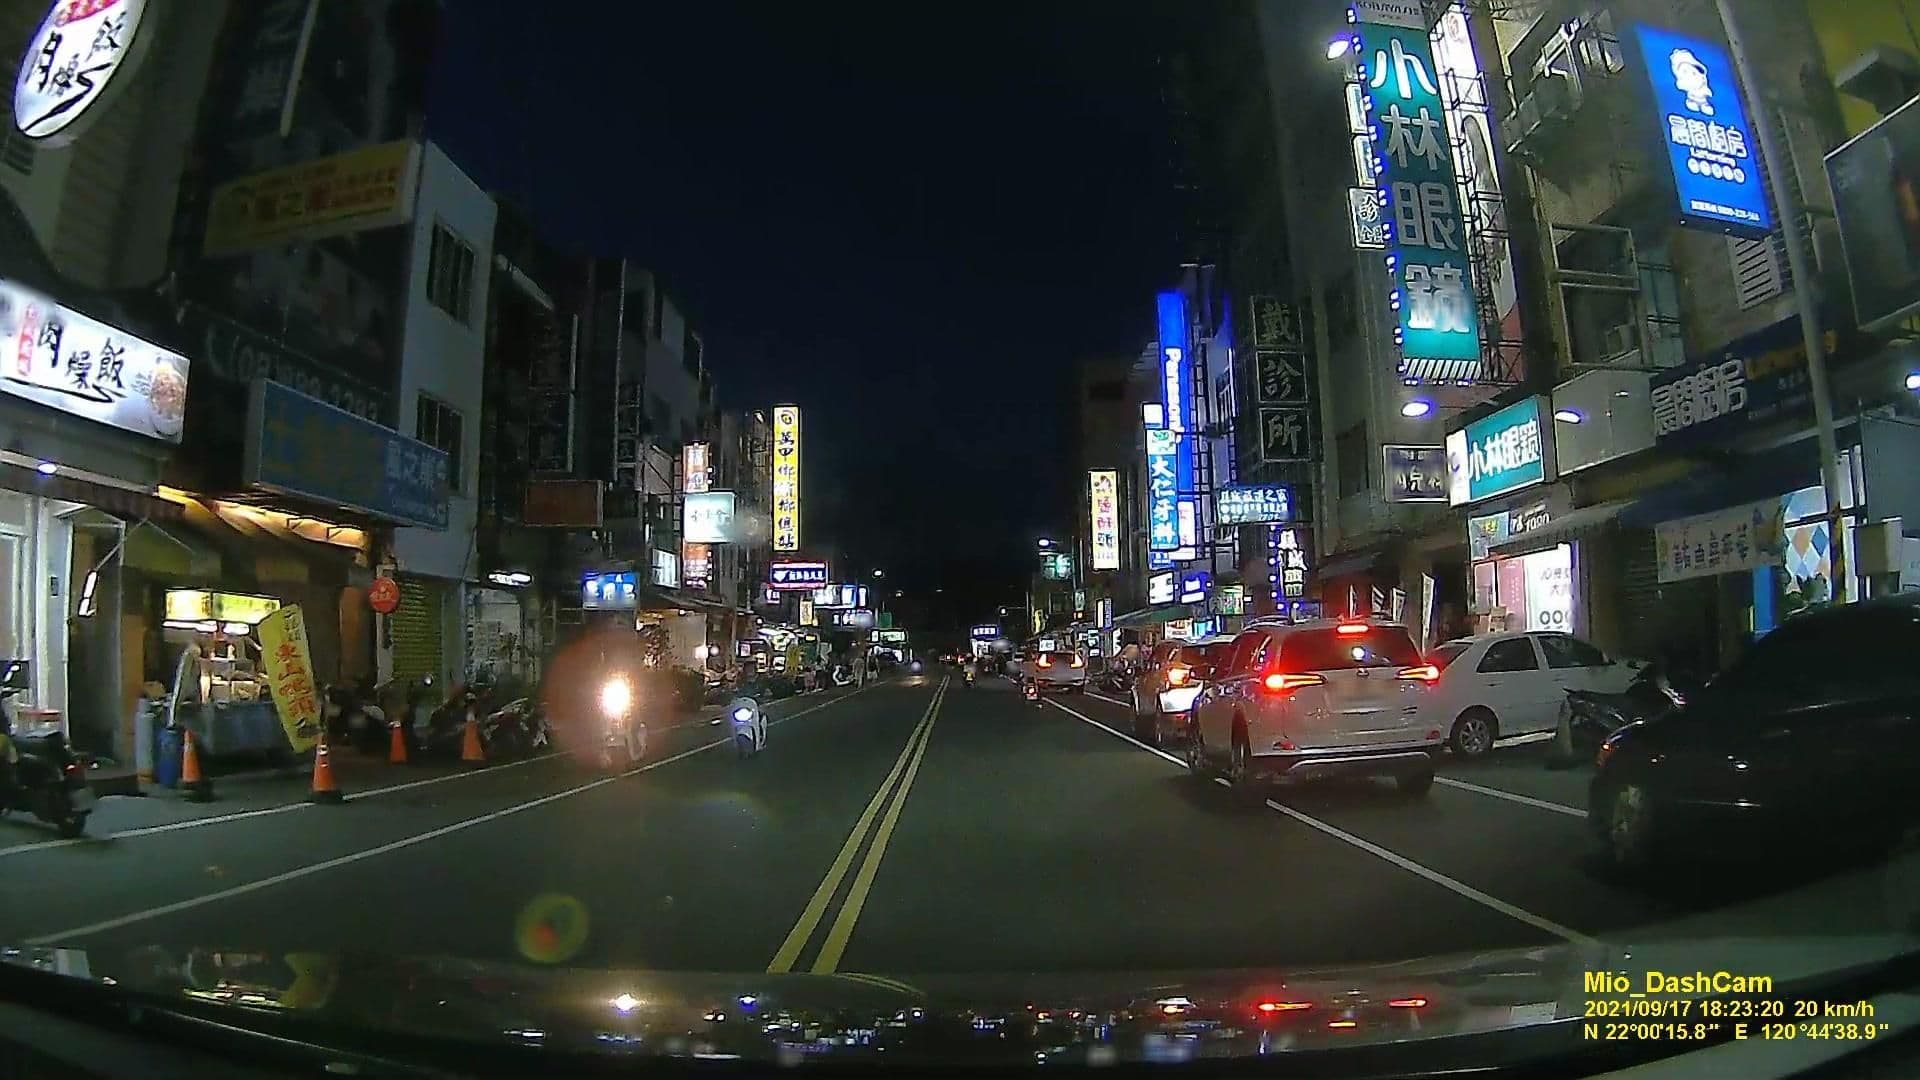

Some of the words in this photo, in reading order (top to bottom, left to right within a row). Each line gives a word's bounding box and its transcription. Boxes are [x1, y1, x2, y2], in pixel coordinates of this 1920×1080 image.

[1668, 115, 1749, 158] 晨間廚房
[1370, 38, 1470, 333] 小林眼鏡
[36, 319, 126, 390] 肉燥飯
[1259, 300, 1302, 455] 戴診所
[1650, 354, 1744, 436] 晨間廚房
[1468, 418, 1539, 482] 小林眼鏡
